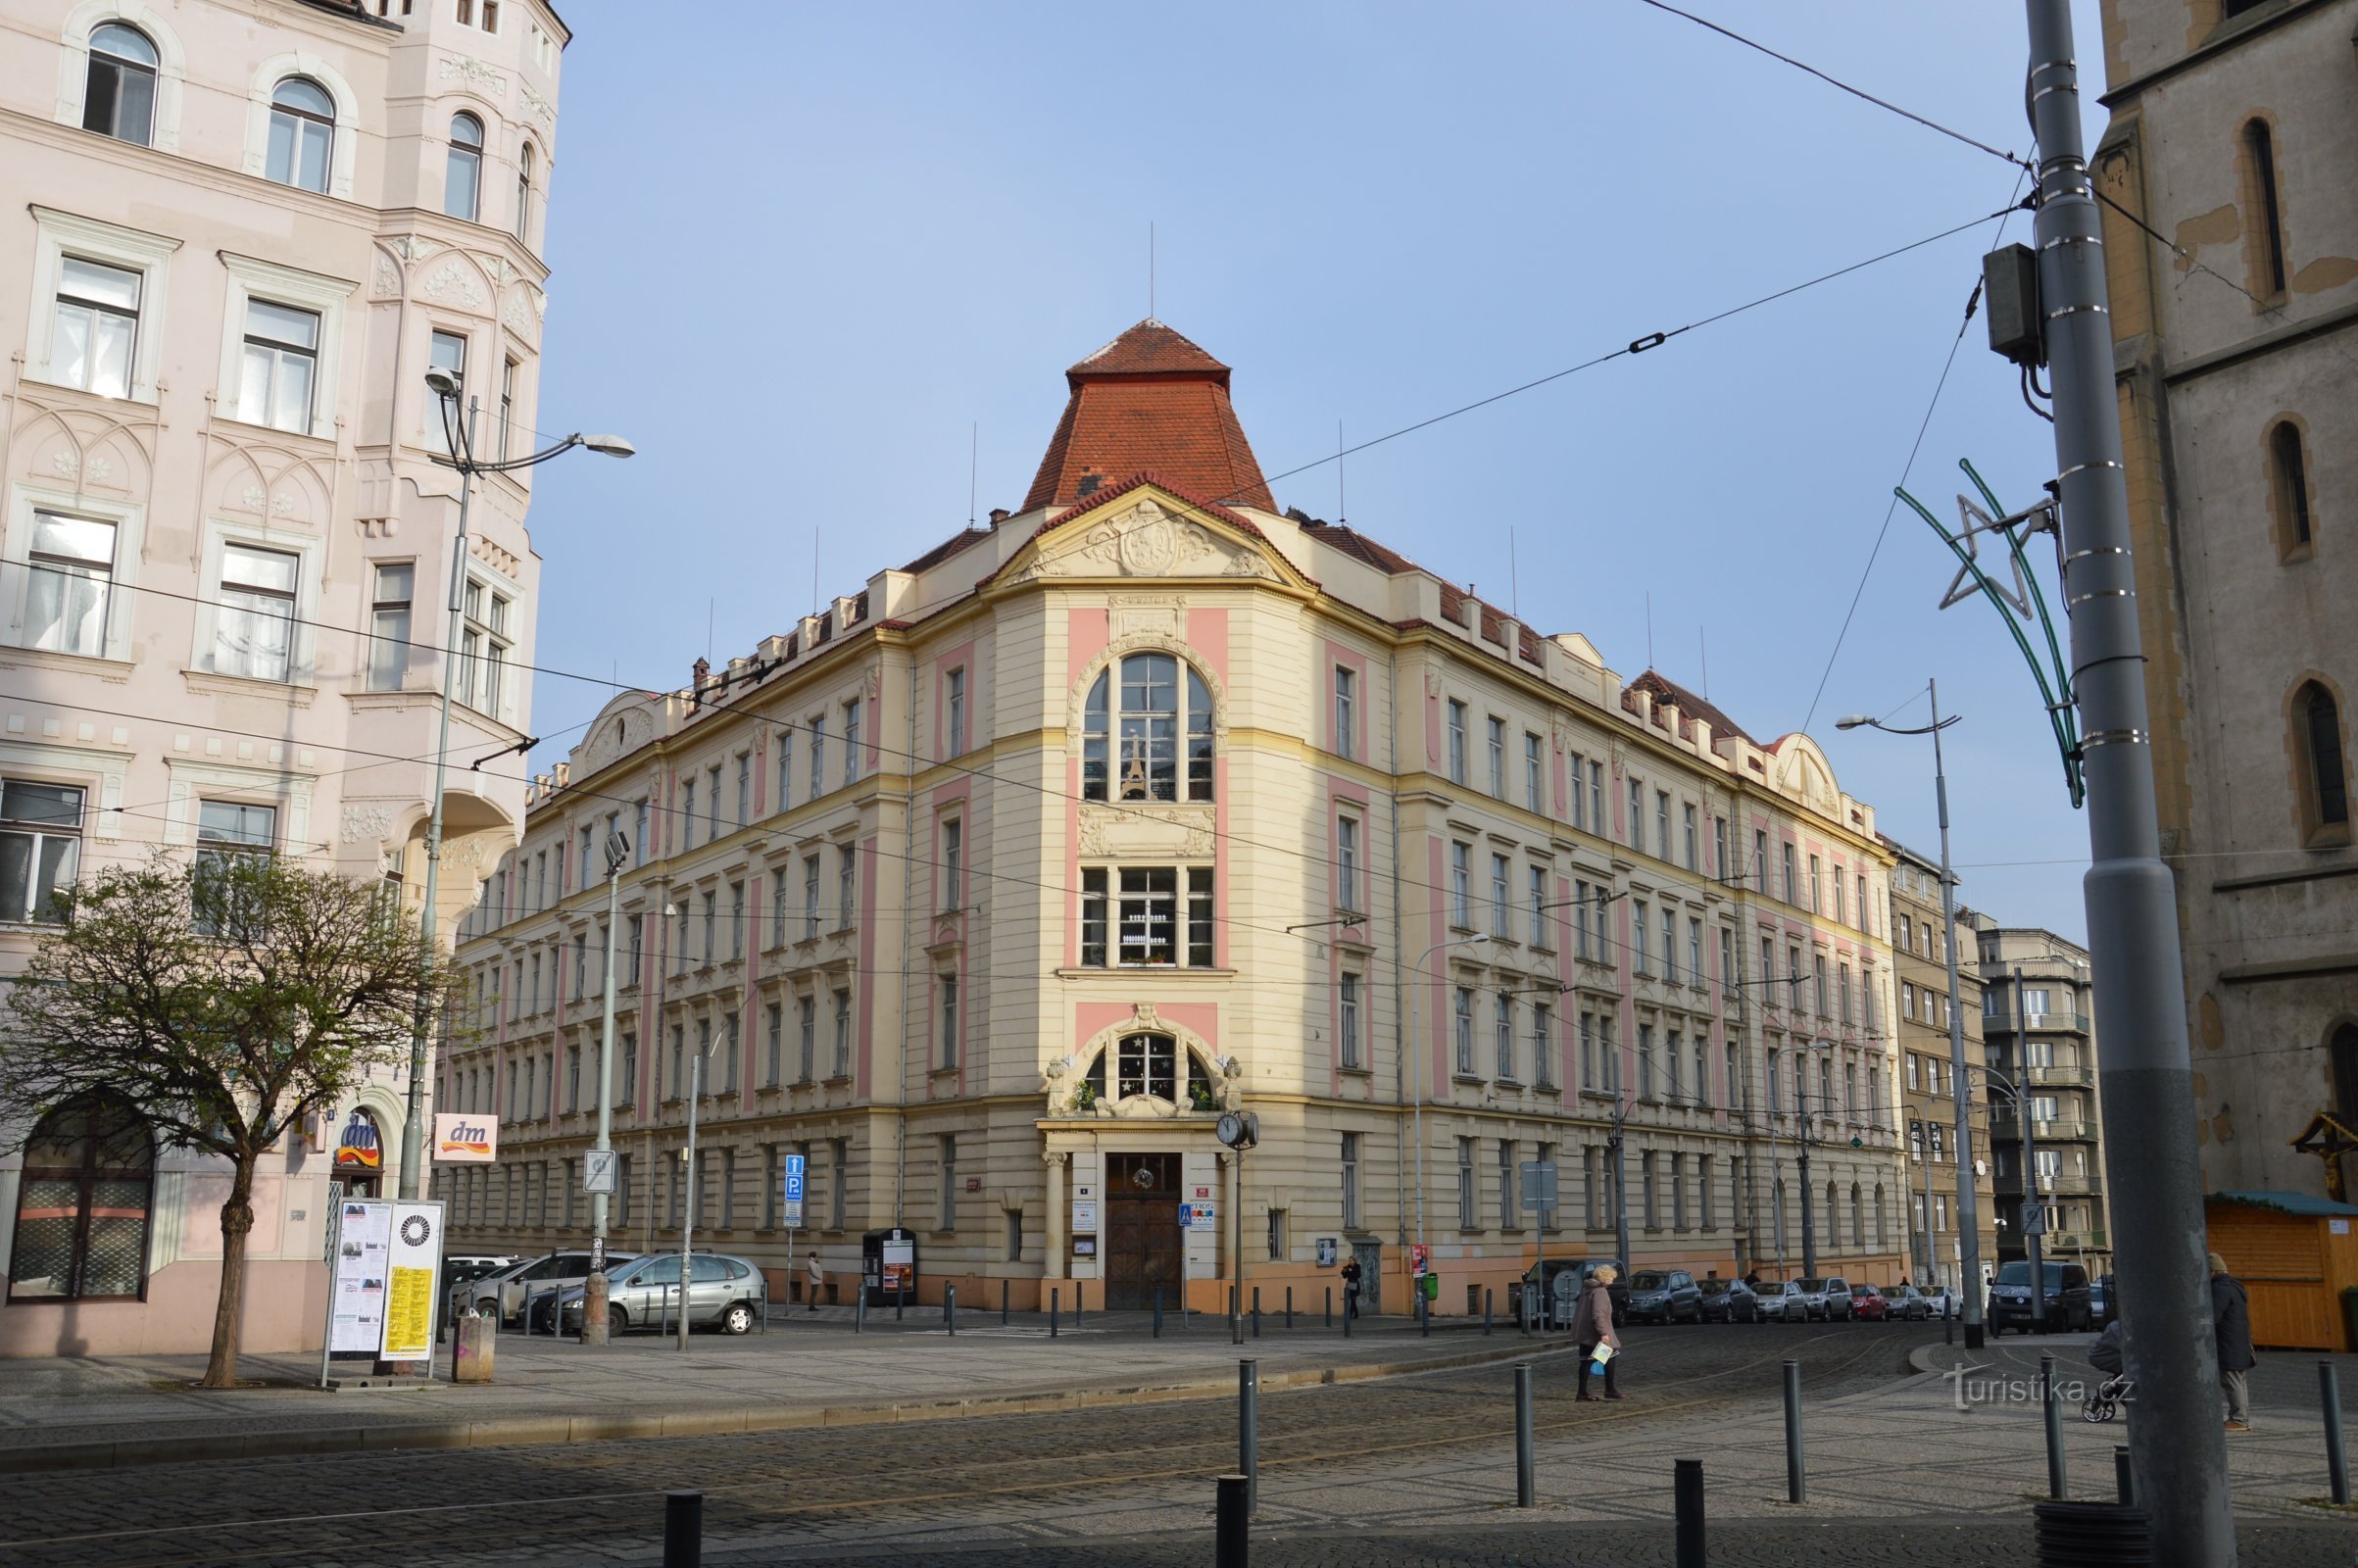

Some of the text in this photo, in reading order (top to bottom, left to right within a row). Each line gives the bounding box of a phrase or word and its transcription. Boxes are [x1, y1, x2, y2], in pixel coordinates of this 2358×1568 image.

[346, 1115, 376, 1148] dm
[450, 1121, 486, 1142] dm
[788, 1177, 800, 1194] P
